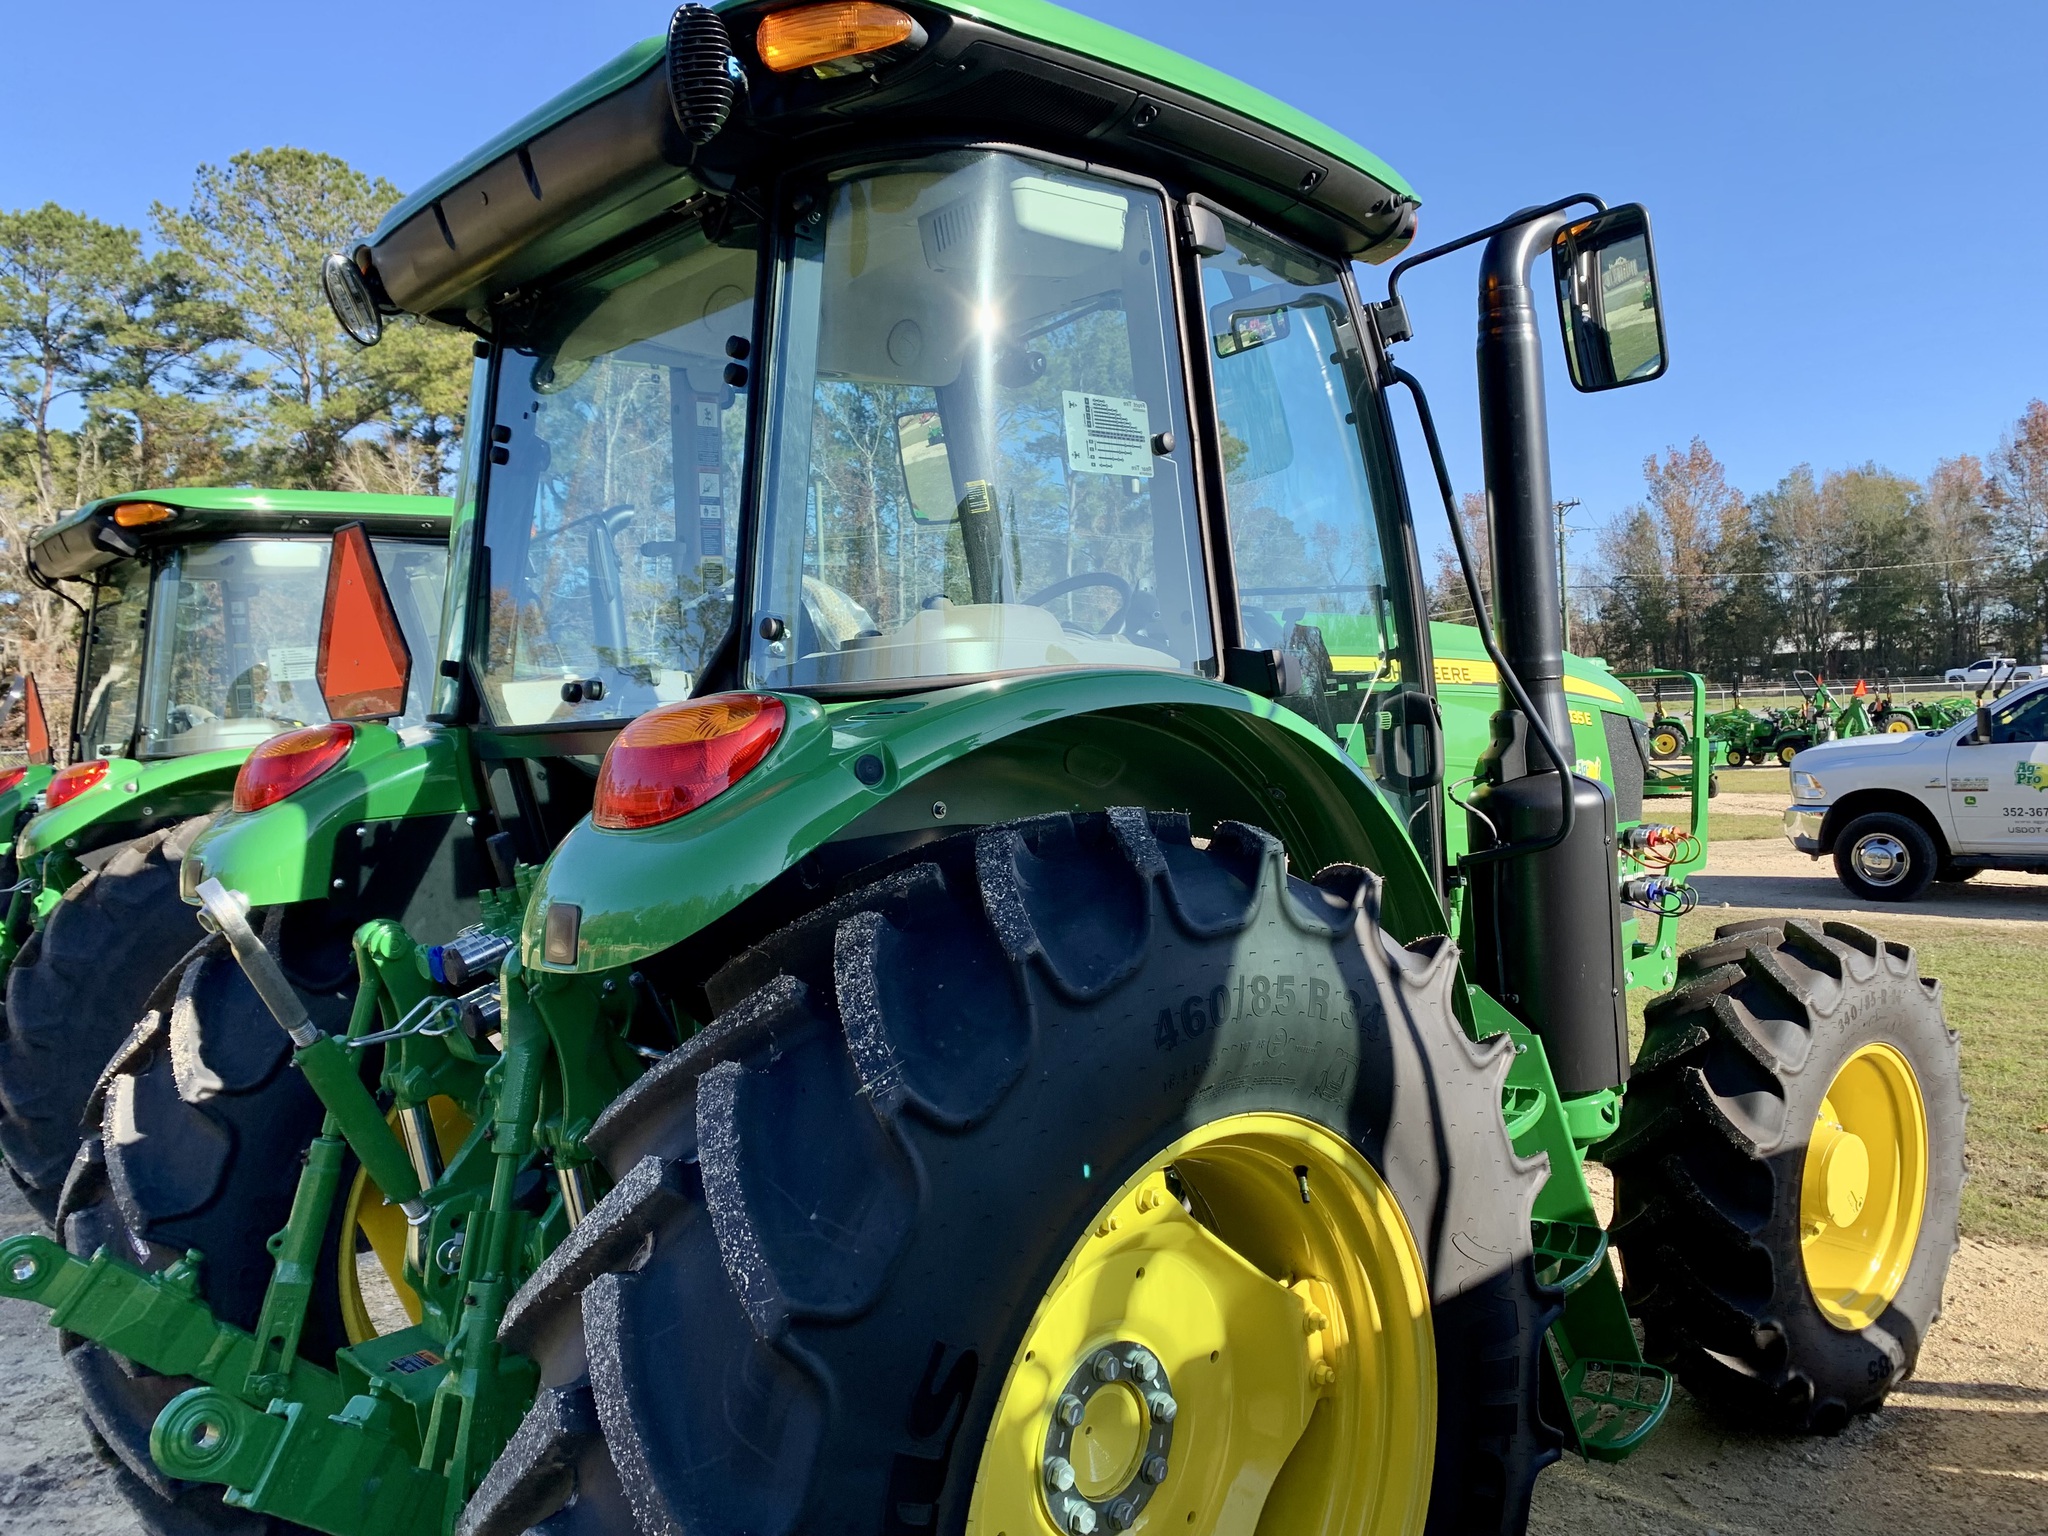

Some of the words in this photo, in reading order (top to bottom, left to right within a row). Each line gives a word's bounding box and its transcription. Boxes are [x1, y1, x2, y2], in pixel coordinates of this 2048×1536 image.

[1434, 666, 1472, 682] EERE
[2016, 773, 2042, 785] Pro
[2003, 807, 2048, 817] 352-367
[2008, 826, 2041, 834] USDOT
[1154, 974, 1296, 1051] 460/85
[1308, 977, 1331, 1021] R
[1340, 989, 1381, 1041] 34
